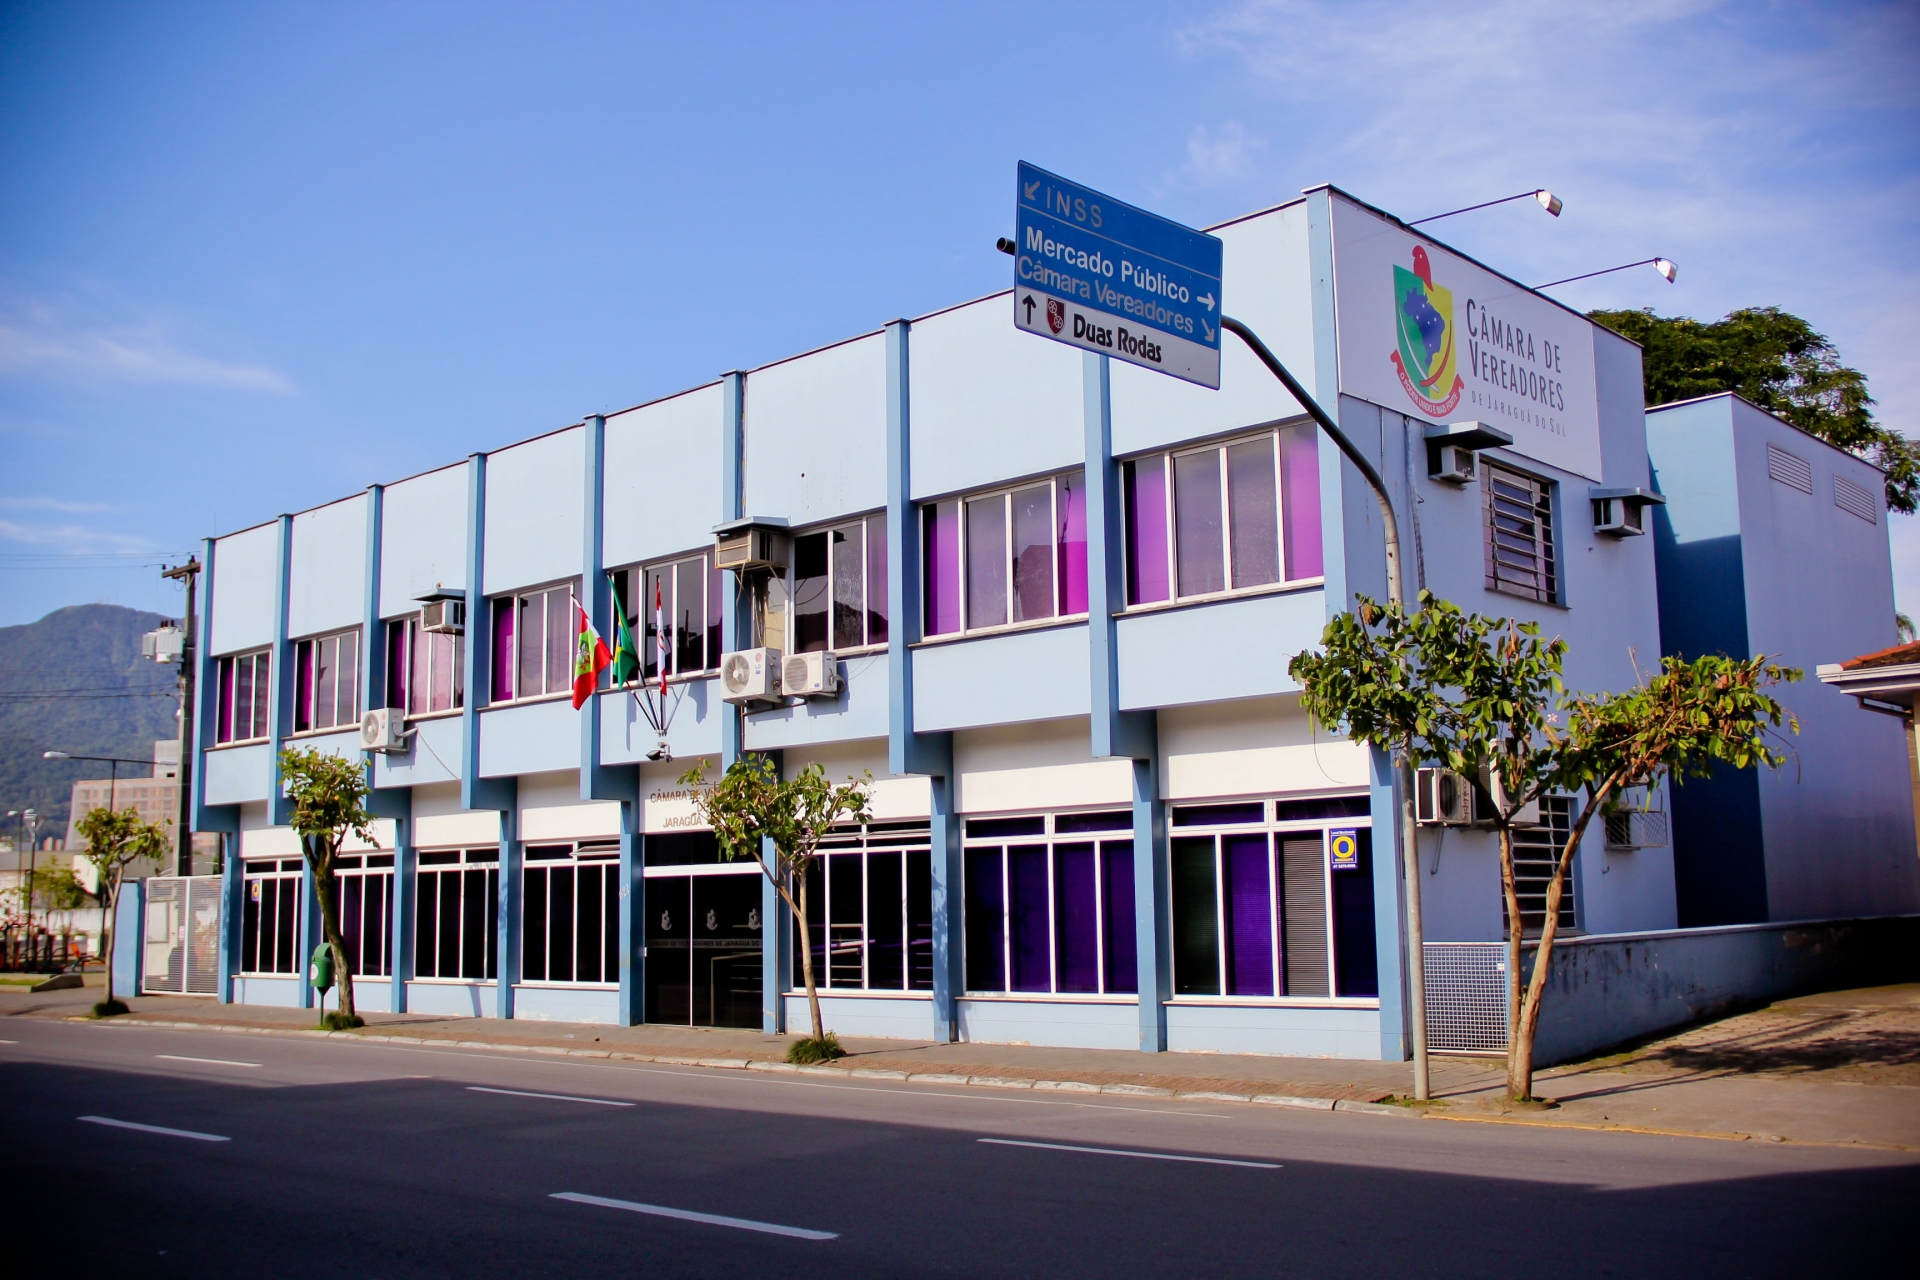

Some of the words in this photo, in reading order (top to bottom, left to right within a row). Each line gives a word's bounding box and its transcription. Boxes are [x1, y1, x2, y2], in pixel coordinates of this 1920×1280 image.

[1047, 187, 1102, 227] INSS
[1018, 255, 1091, 299] Câmara
[1094, 280, 1194, 333] Vereadores
[1026, 226, 1114, 277] Mercado
[1121, 260, 1190, 303] Público
[1073, 313, 1113, 347] Duas
[1117, 327, 1162, 363] Rodas
[1466, 298, 1536, 363] CÂMARA
[1544, 340, 1561, 374] DE
[1469, 338, 1564, 411] VEREADORES
[1471, 390, 1482, 406] DE
[1486, 394, 1531, 424] JARAGUÁ
[1535, 414, 1546, 429] DO
[650, 788, 687, 803] CÂMARA
